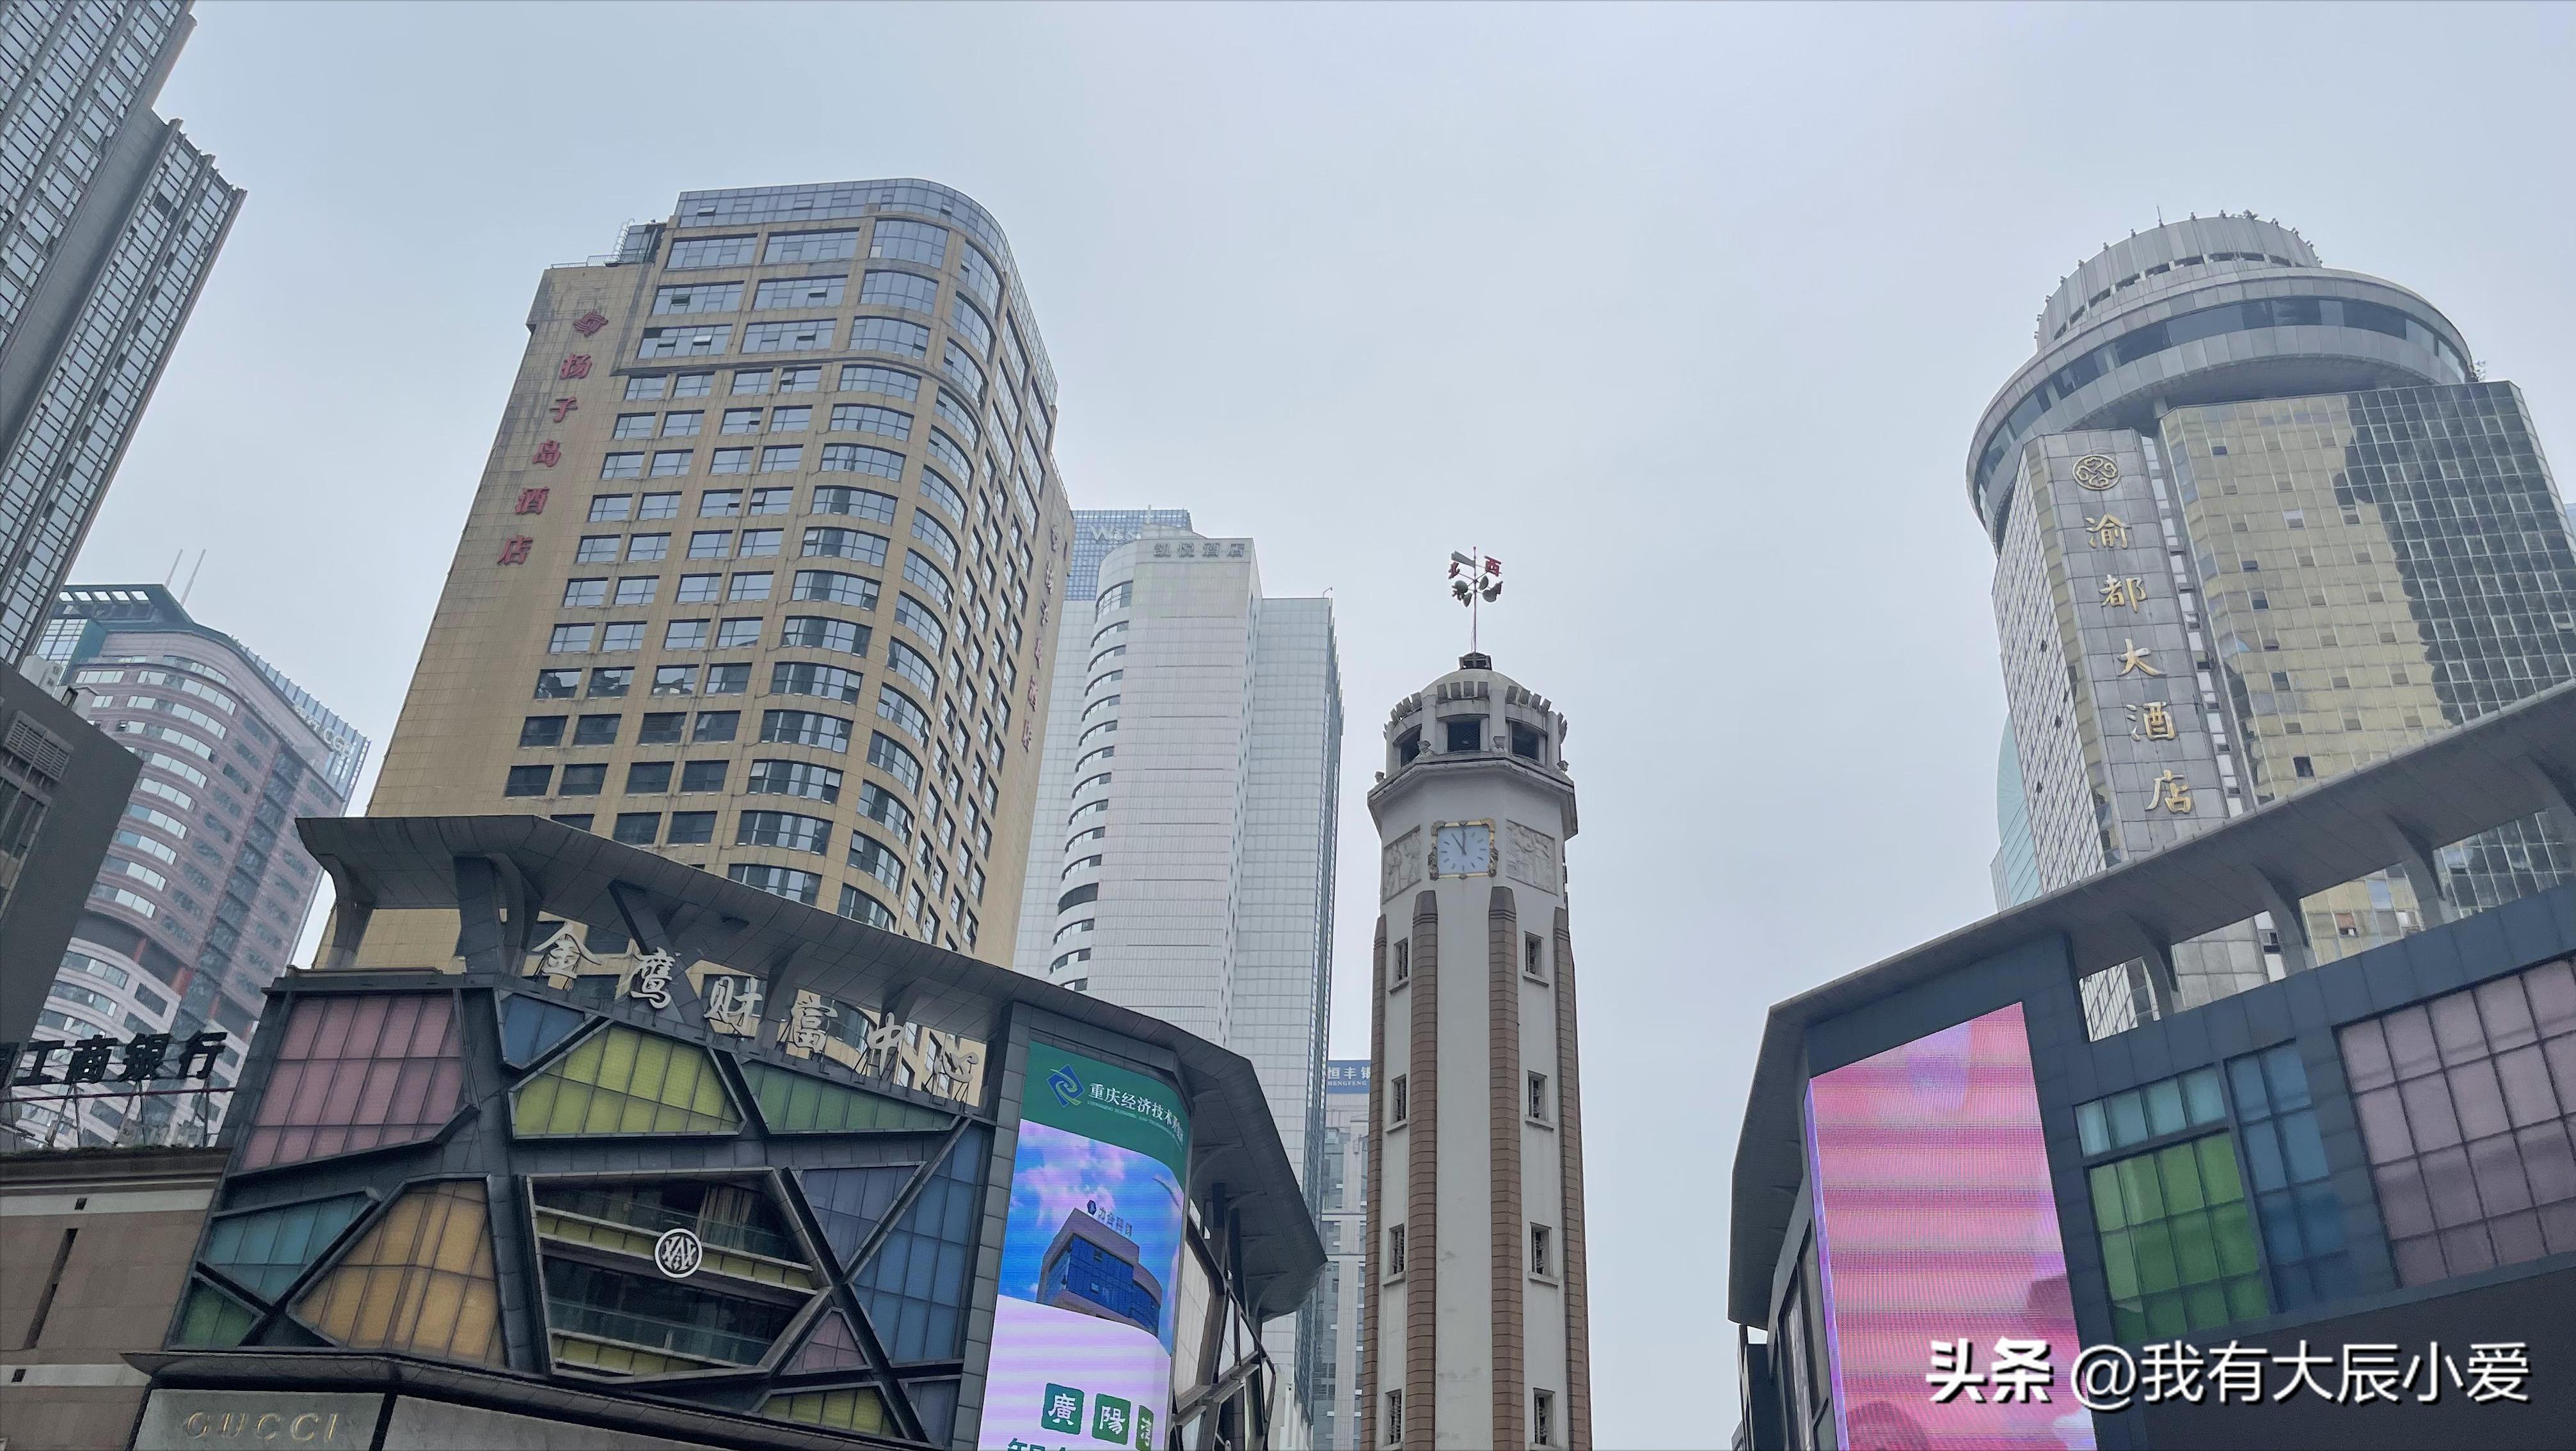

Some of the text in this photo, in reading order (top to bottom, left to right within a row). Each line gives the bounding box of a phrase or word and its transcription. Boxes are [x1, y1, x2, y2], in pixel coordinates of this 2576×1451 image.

[498, 353, 592, 566] 扬子岛酒店
[2084, 512, 2192, 814] 渝都大酒店
[0, 1031, 228, 1086] 工商銀行
[183, 1411, 338, 1441] GUCCI
